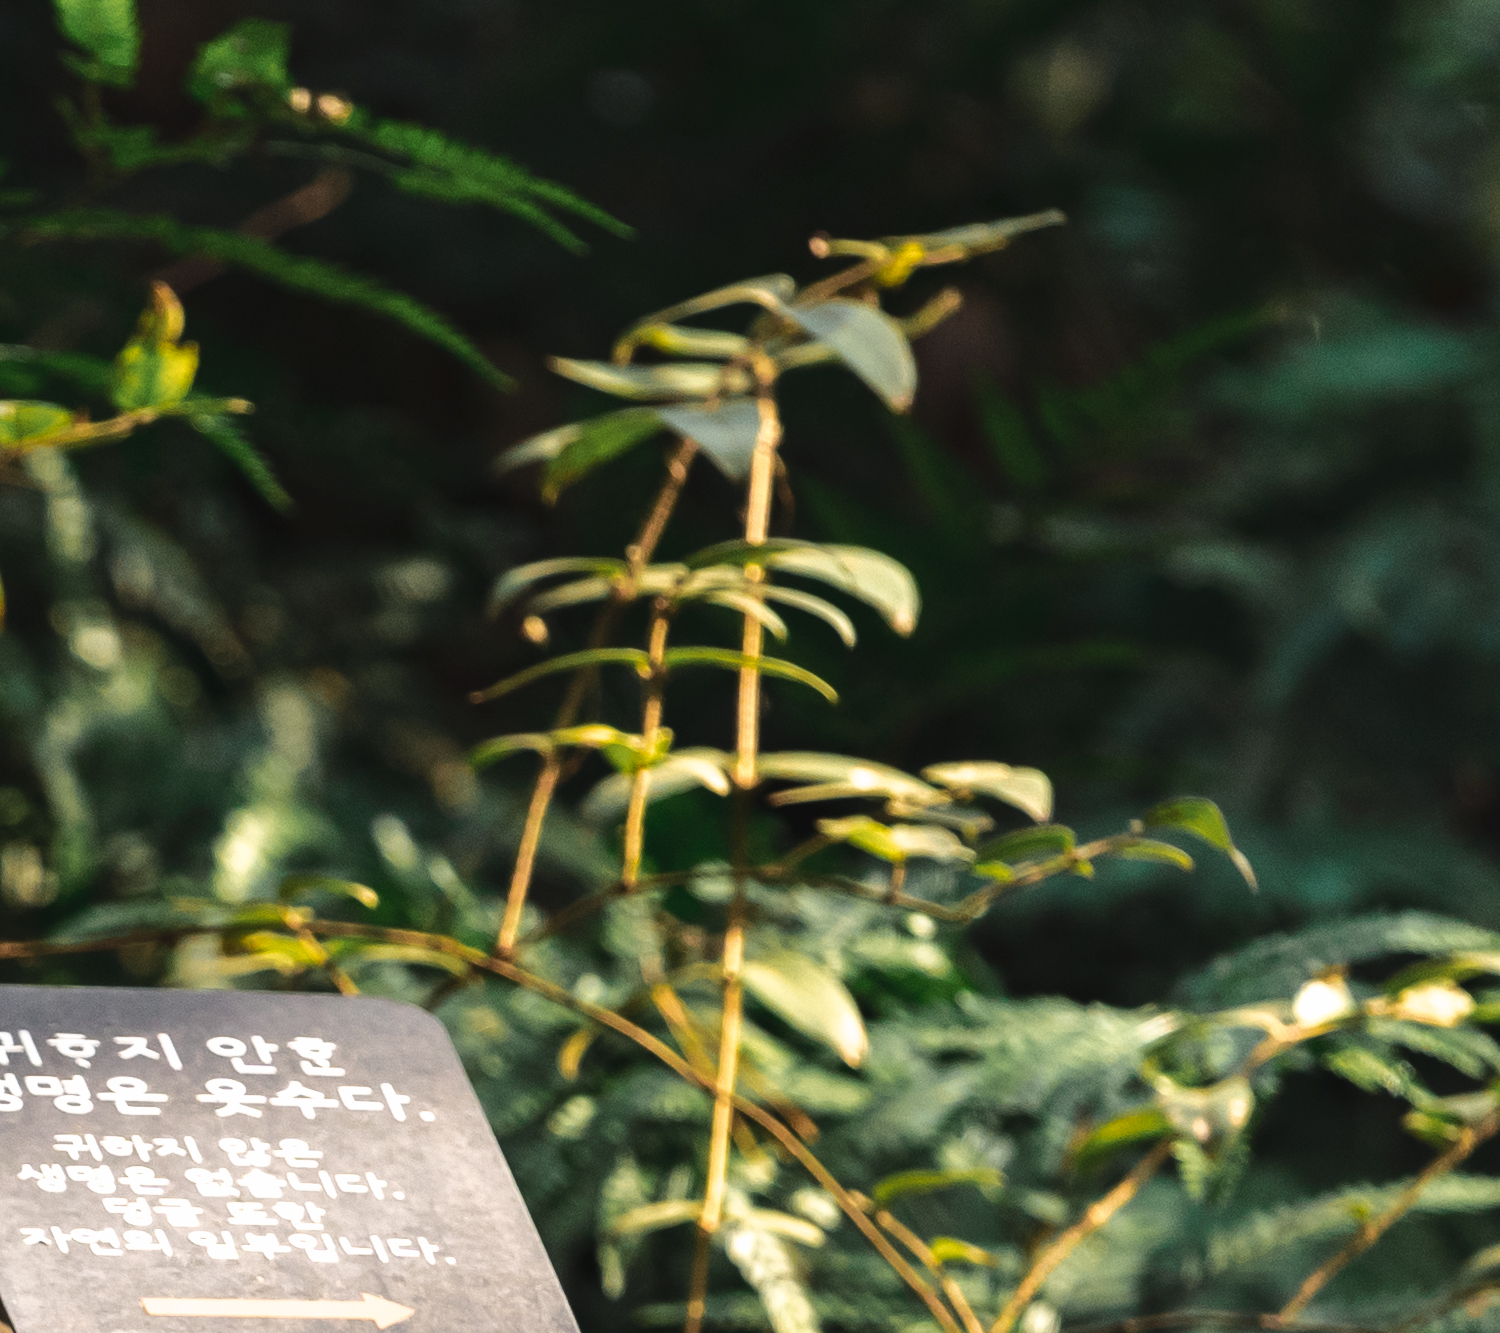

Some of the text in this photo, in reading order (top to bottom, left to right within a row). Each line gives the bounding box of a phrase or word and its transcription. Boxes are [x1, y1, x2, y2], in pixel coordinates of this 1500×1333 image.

[51, 1132, 325, 1170] 귀하지 않은
[15, 1162, 407, 1202] 생명은 없습니다.
[100, 1195, 328, 1232] 덩굴 또한
[17, 1224, 458, 1267] 자연의 일부입니다.
